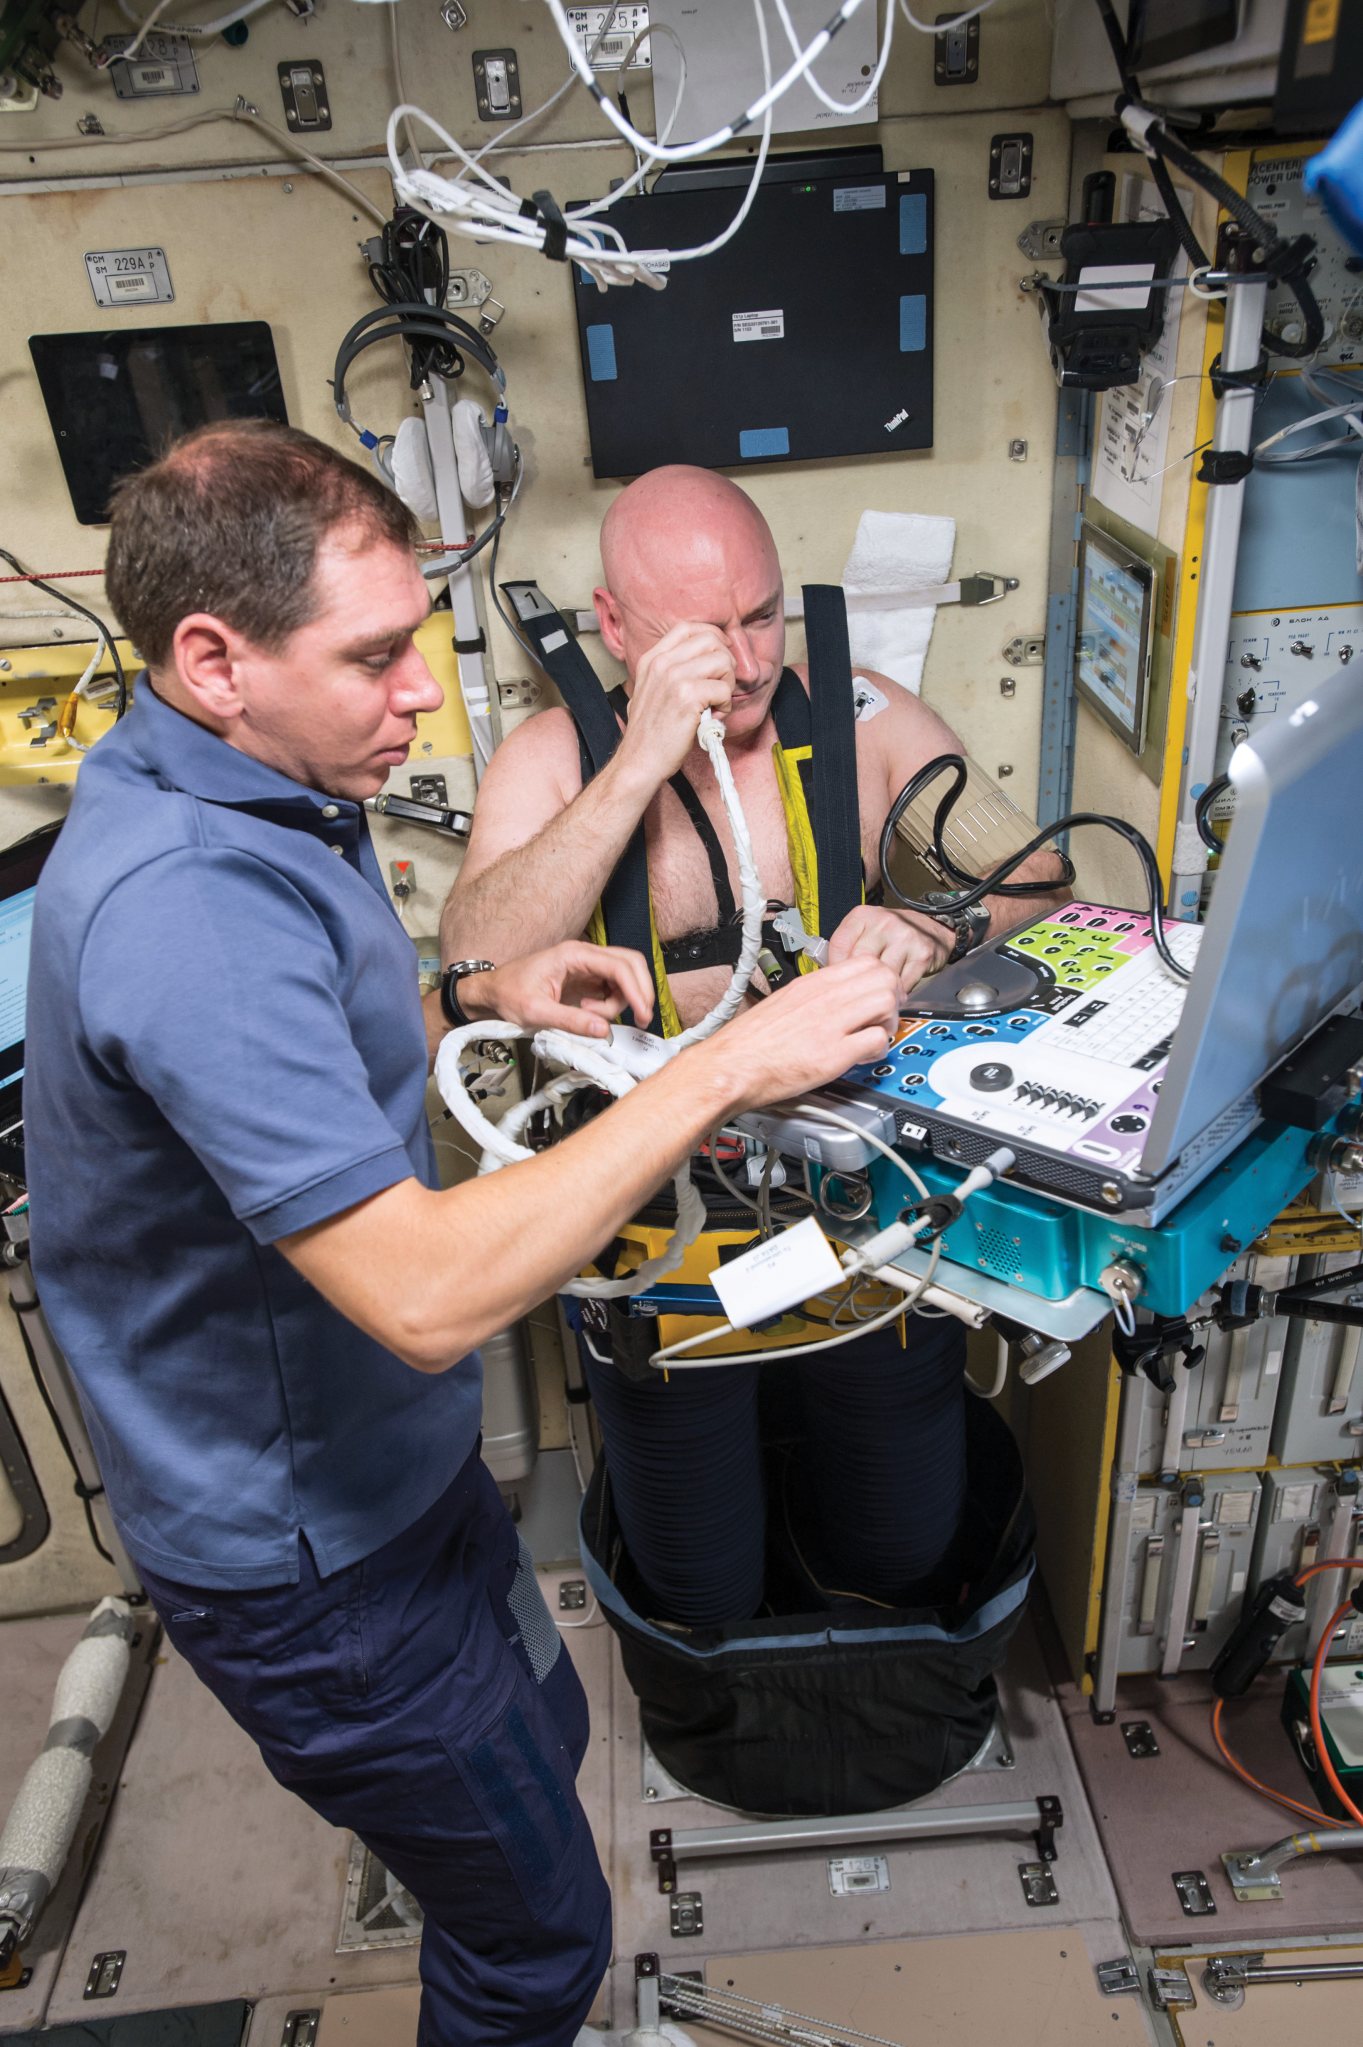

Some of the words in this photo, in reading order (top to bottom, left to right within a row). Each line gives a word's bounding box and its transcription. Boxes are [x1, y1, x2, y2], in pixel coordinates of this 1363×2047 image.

[1248, 174, 1283, 185] POWER
[115, 257, 145, 271] 229A
[884, 408, 909, 432] ThinkPad
[524, 590, 539, 609] 1
[941, 1033, 957, 1042] 4
[862, 1076, 882, 1086] 6
[898, 1086, 918, 1096] 3
[1132, 1104, 1149, 1112] 6
[761, 1244, 778, 1256] DATA
[751, 1250, 782, 1270] Ultrasound
